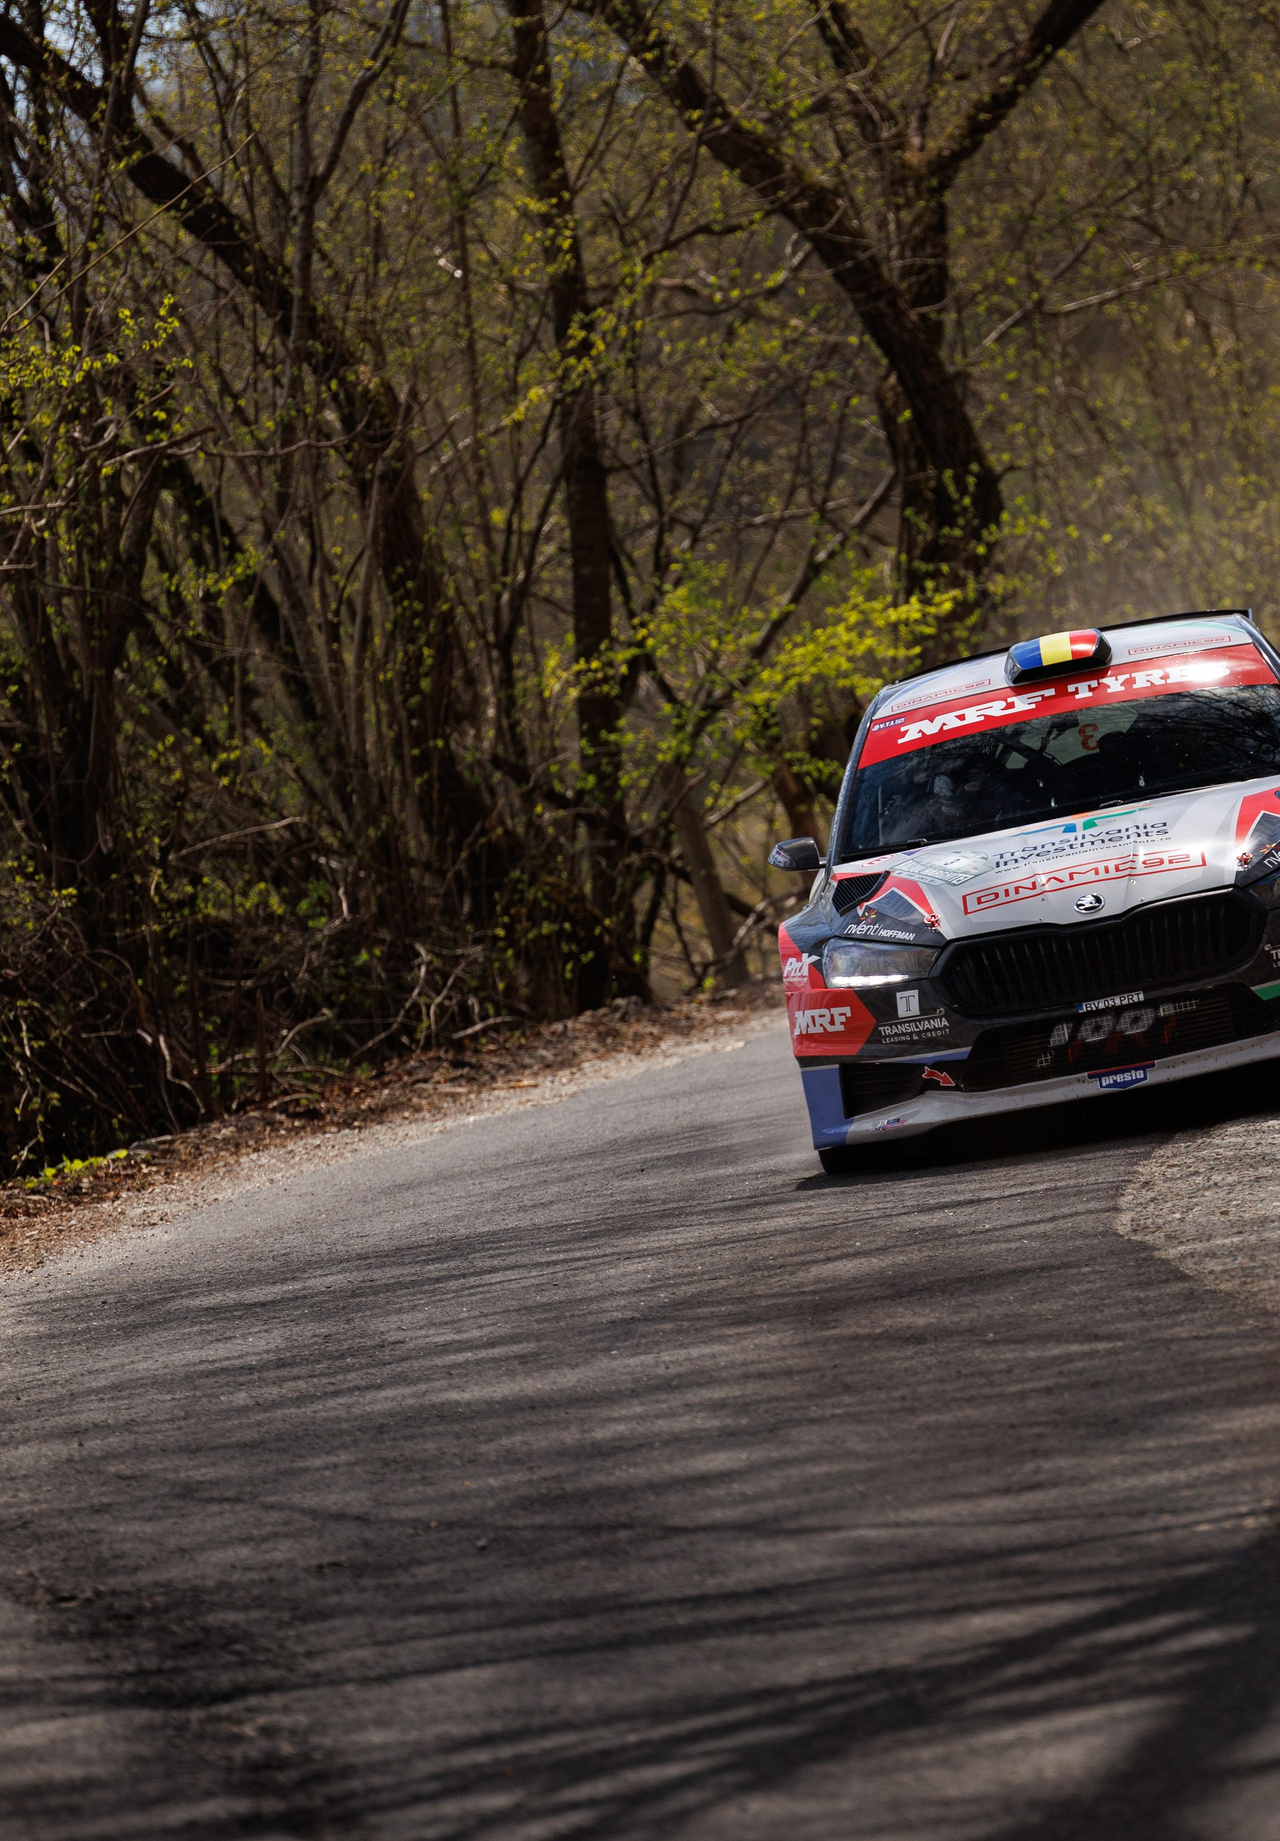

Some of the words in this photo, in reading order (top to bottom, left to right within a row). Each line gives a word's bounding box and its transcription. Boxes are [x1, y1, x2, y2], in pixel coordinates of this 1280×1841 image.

[897, 688, 1056, 744] MRF
[993, 822, 1168, 860] Transilvania
[995, 828, 1169, 868] Investments
[880, 928, 916, 940] HOFFMAN
[1084, 1001, 1100, 1012] BV
[1104, 997, 1116, 1008] 03
[1120, 992, 1142, 1006] PRT
[794, 1006, 852, 1036] MRF
[878, 1017, 950, 1037] TRANSILVANIA
[882, 1034, 911, 1044] LEASING
[922, 1028, 950, 1038] CREDIT
[1101, 1069, 1144, 1087] presto
